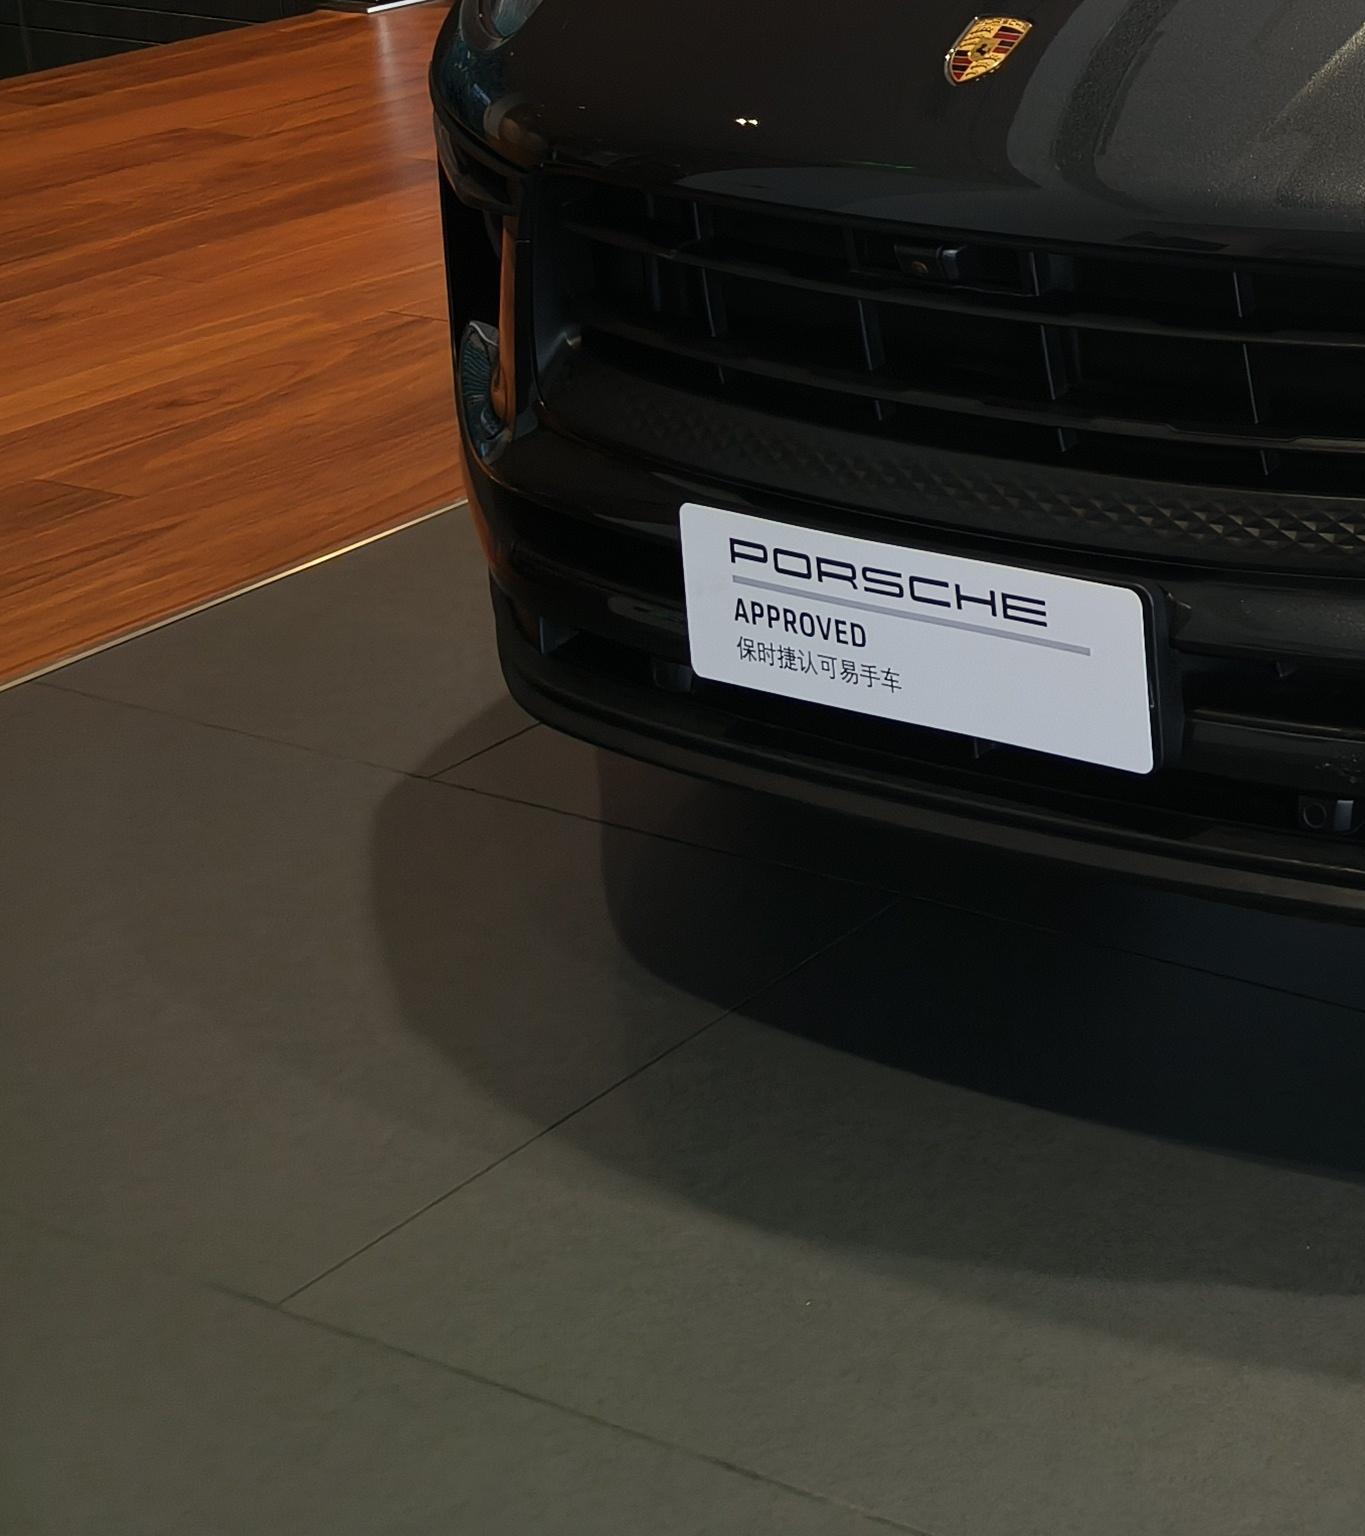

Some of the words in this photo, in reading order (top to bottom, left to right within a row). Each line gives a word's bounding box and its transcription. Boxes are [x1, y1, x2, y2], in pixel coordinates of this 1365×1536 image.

[729, 537, 1048, 627] PORSCHE
[734, 597, 867, 648] APPROVED
[735, 635, 903, 694] 保时捷认可易手车
